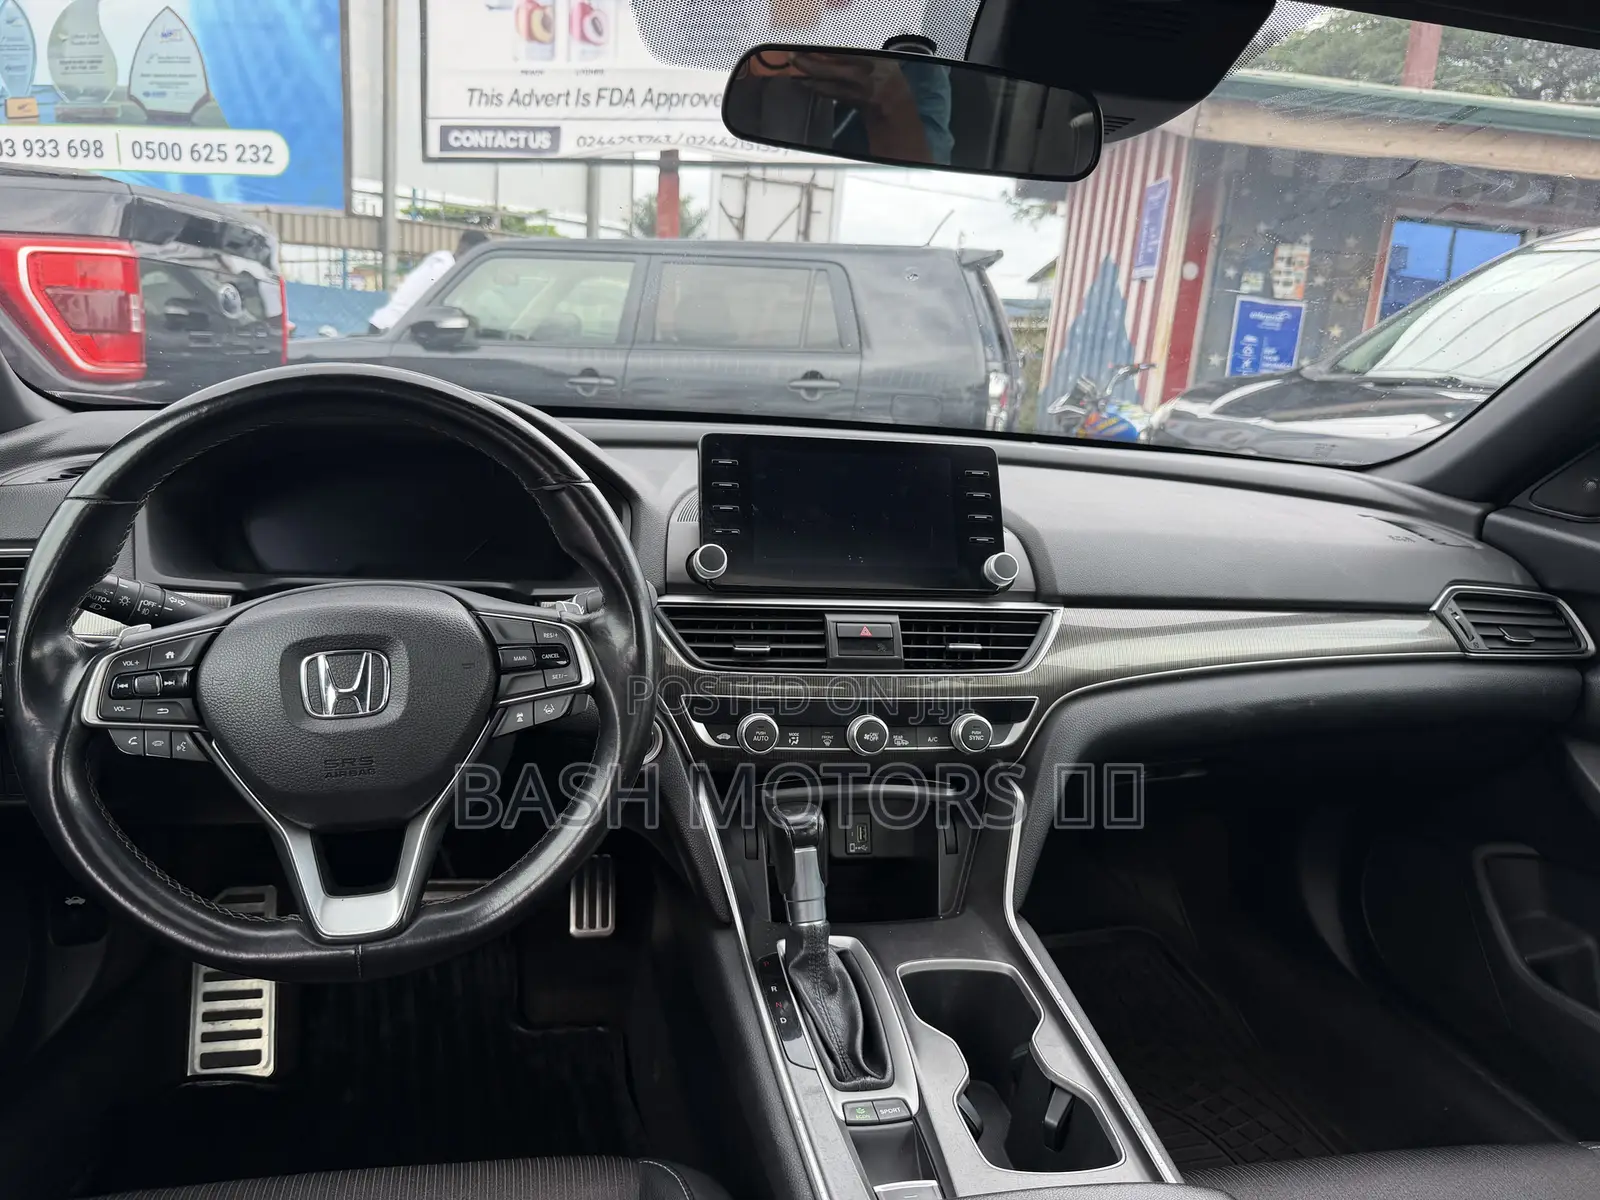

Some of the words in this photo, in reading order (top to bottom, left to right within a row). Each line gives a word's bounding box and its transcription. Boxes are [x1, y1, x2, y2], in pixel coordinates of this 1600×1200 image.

[467, 88, 504, 107] This
[508, 87, 571, 107] Advert
[575, 87, 592, 108] Is
[596, 87, 636, 107] FDA
[640, 87, 723, 112] Approve
[23, 138, 60, 158] 933
[67, 139, 104, 158] 698
[131, 140, 182, 162] 0500
[190, 143, 228, 163] 625
[235, 143, 275, 164] 232
[541, 652, 560, 660] CANCEL
[879, 1106, 901, 1115] SPORT
